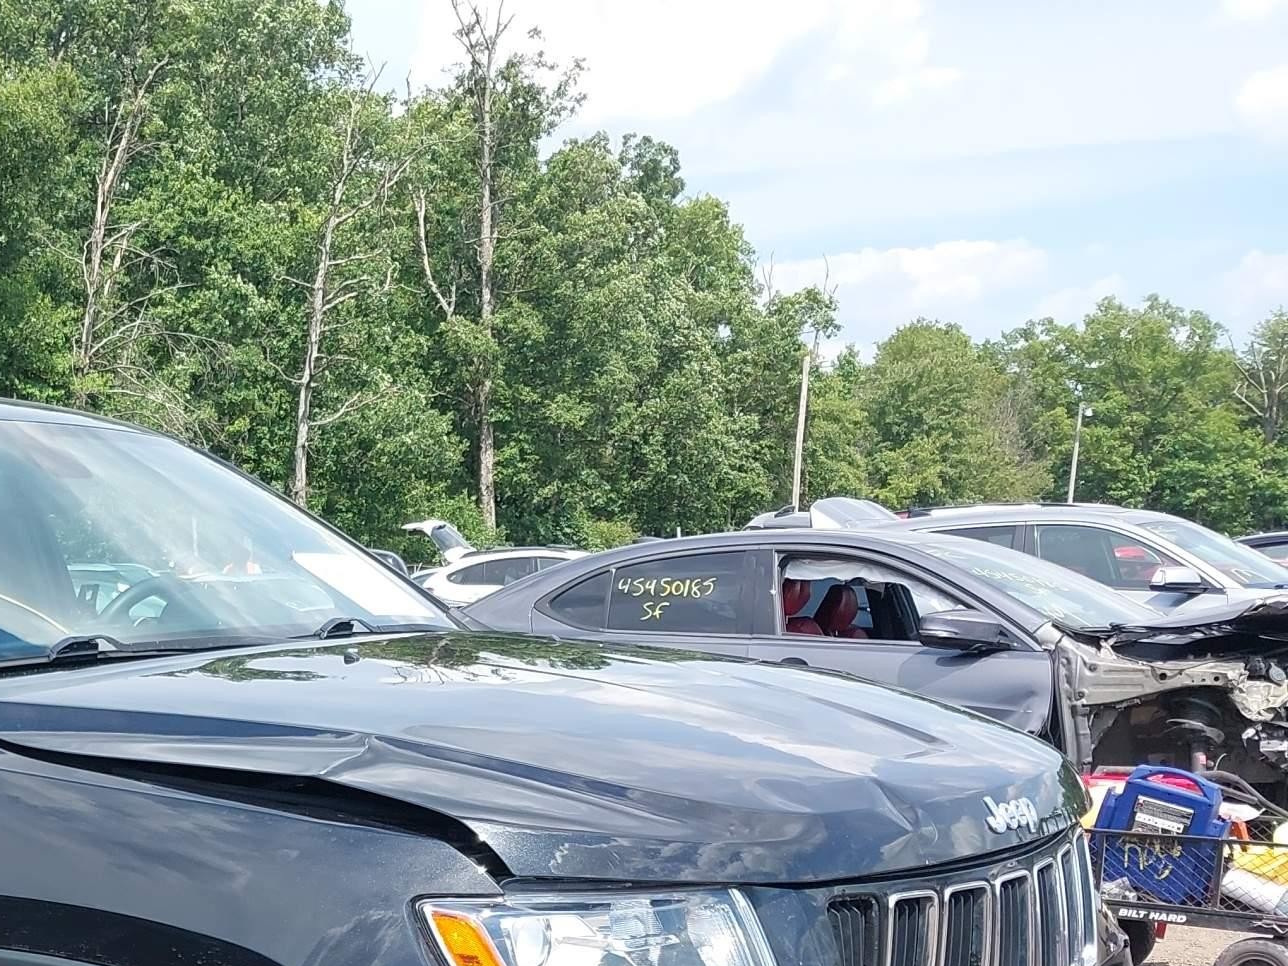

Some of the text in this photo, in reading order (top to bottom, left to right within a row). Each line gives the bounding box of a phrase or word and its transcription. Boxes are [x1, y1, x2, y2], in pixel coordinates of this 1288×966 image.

[618, 577, 717, 598] 45450185
[982, 795, 1038, 834] Jeep
[1118, 908, 1187, 923] BILT HARD
